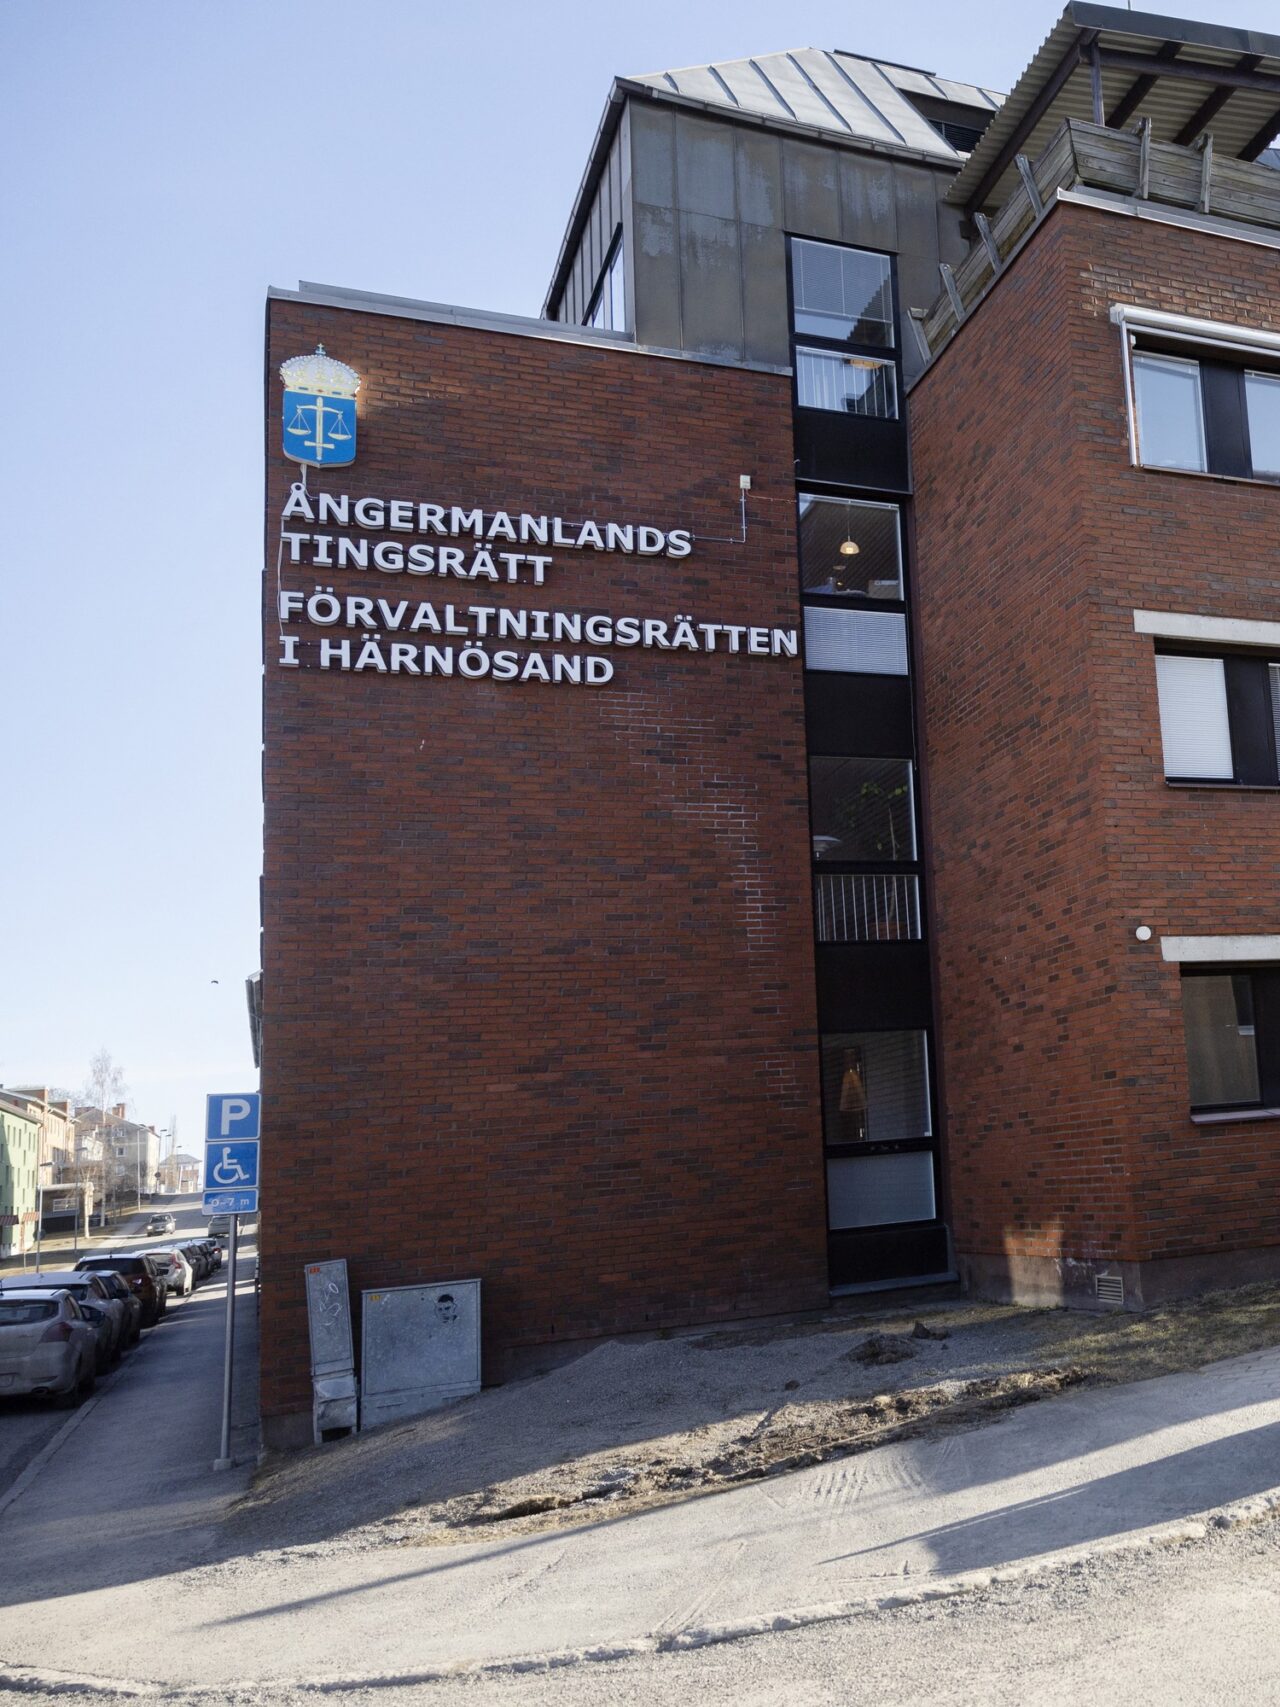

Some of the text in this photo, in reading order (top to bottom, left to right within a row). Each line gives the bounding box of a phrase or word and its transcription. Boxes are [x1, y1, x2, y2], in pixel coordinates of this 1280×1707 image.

[281, 481, 692, 559] ÅNGERMANLANDS
[281, 530, 553, 586] TINGSRÄTT
[279, 586, 799, 658] FÖRVALTNINGSRÄTTEN
[279, 633, 615, 686] I HÄRNÖSAND
[220, 1098, 251, 1136] P
